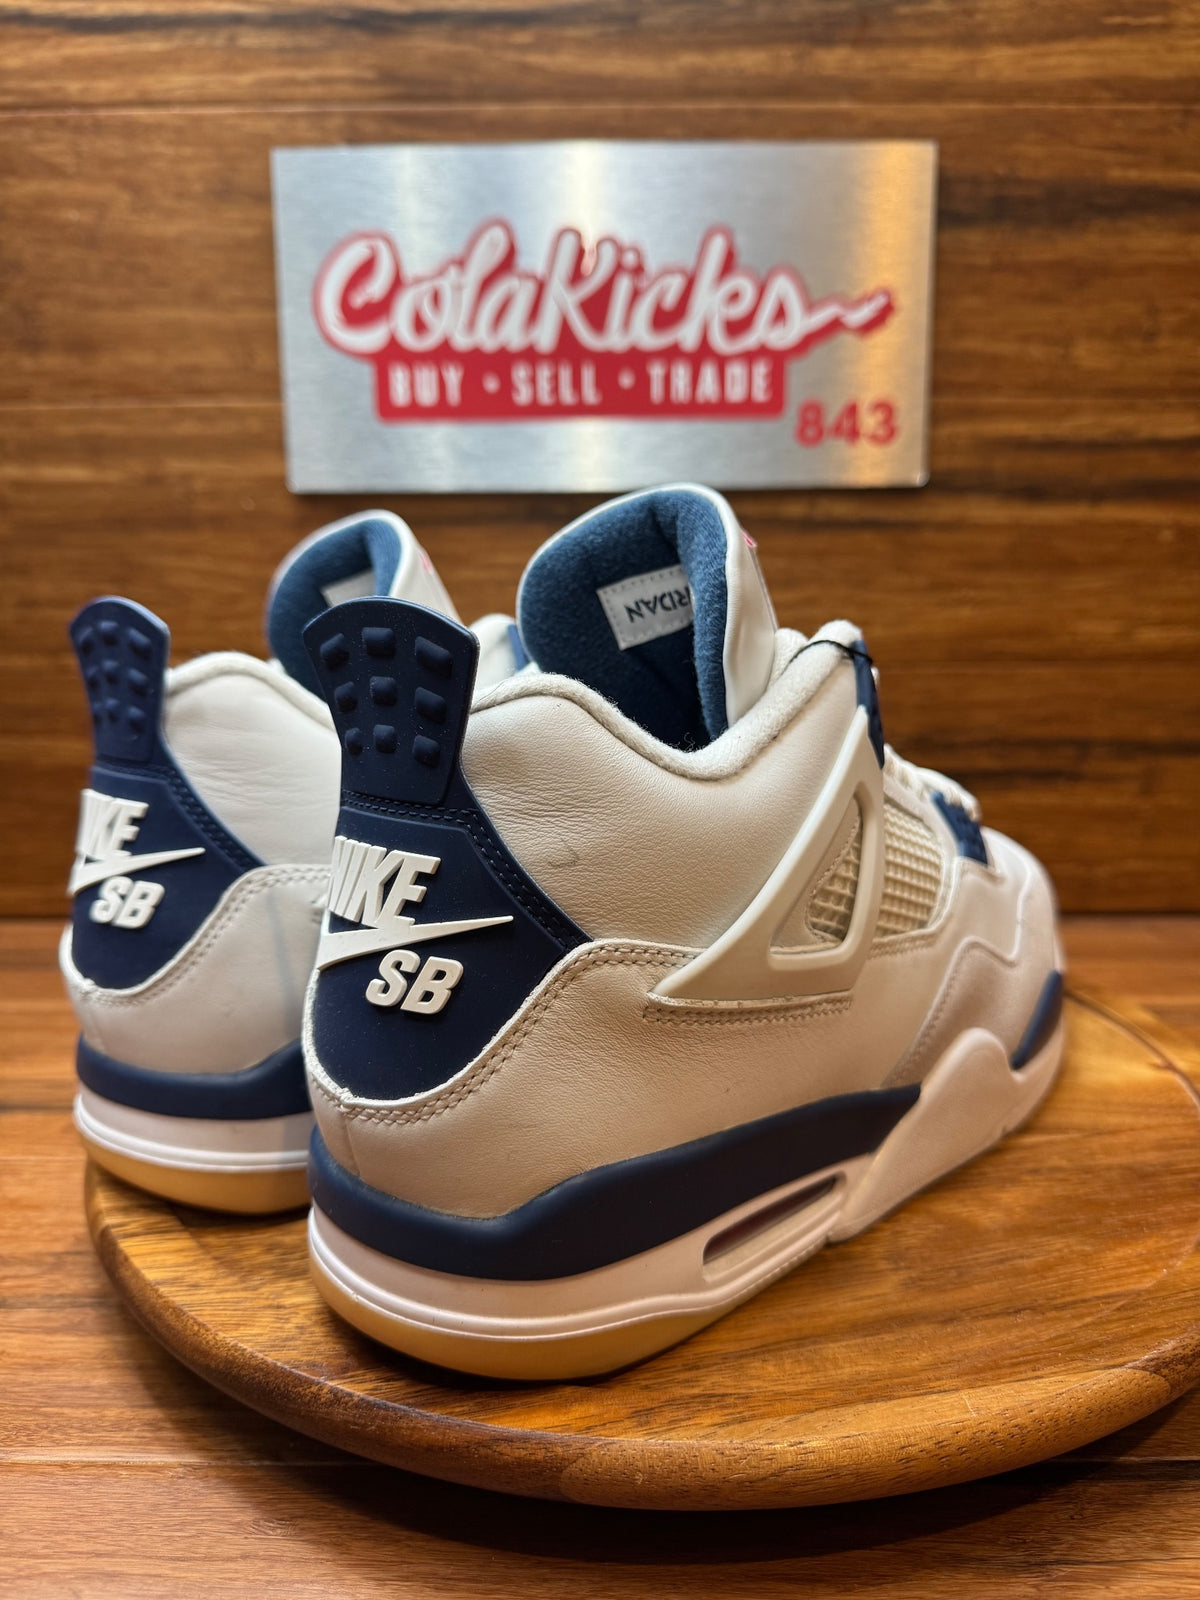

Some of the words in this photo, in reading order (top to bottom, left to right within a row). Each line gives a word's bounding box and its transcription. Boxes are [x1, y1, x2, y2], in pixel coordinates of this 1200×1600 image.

[314, 221, 893, 355] ColaKicks
[388, 361, 465, 408] BUY
[511, 360, 602, 406] SELL
[646, 357, 773, 404] TRADE
[795, 400, 897, 447] 843
[624, 585, 692, 624] RDAN
[89, 875, 165, 929] SB
[327, 835, 442, 930] NIKE
[365, 949, 464, 1015] SB
